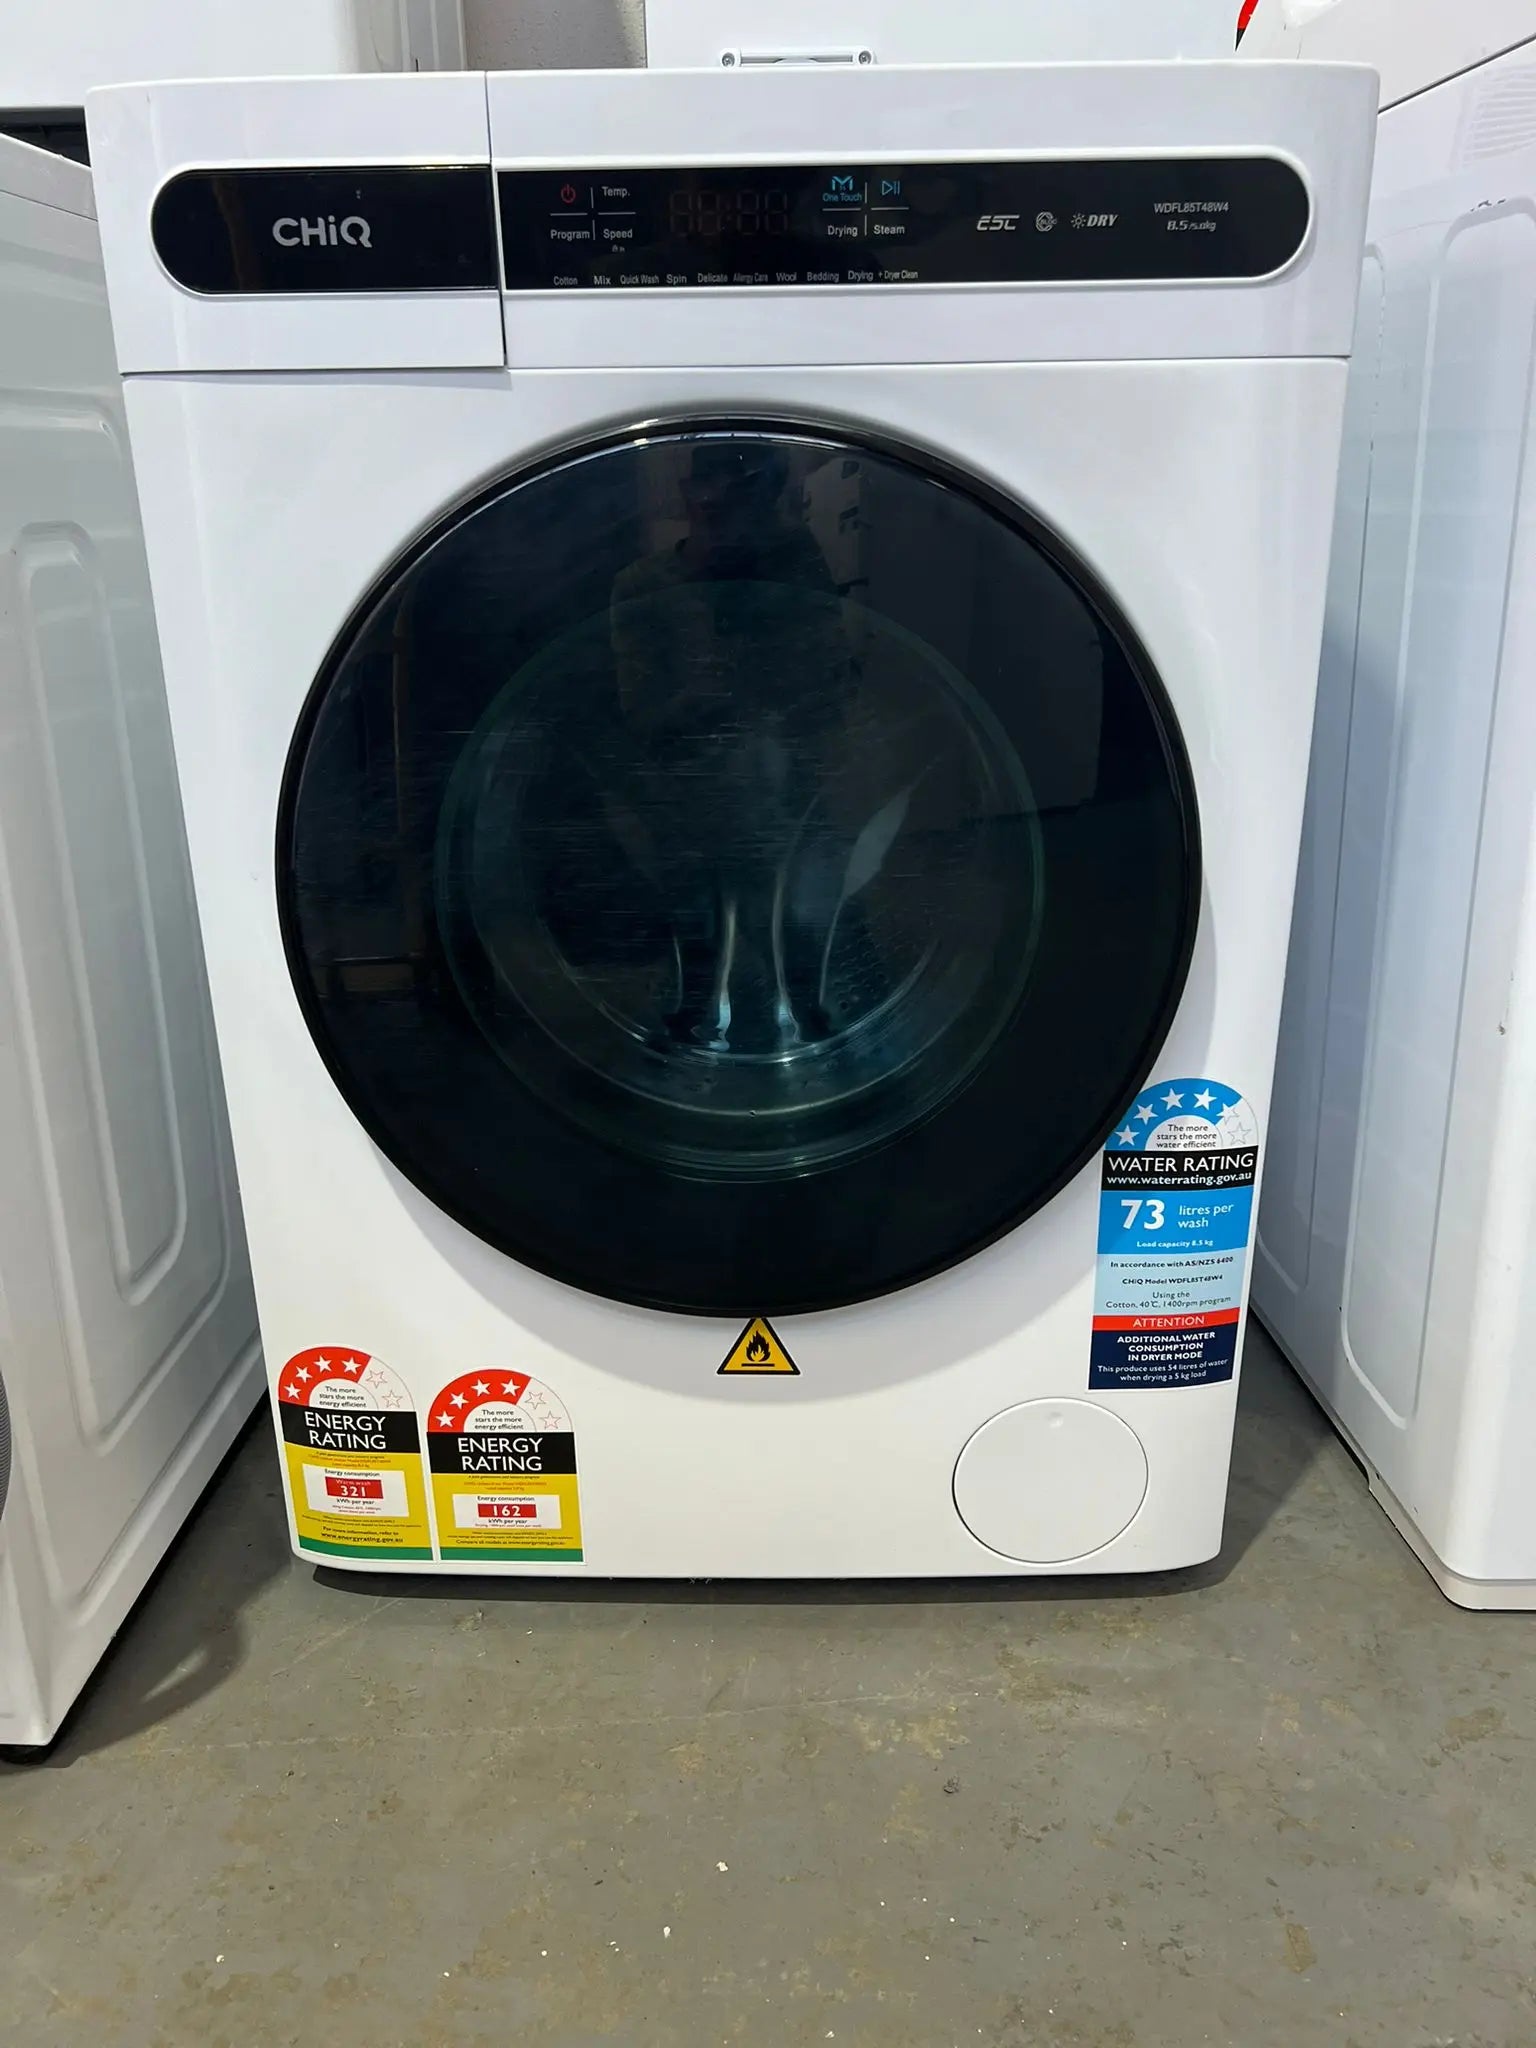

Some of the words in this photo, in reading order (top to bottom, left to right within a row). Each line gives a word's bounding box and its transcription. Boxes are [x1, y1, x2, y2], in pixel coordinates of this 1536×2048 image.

[602, 186, 630, 197] Temp.
[822, 193, 839, 202] One
[840, 192, 862, 202] Touch
[1154, 202, 1229, 213] WDFL85T48W4
[1087, 214, 1118, 227] DRY
[272, 215, 372, 248] CHiQ
[550, 229, 590, 241] Program
[603, 229, 633, 240] Speed
[827, 225, 858, 237] Drying
[873, 224, 905, 235] Steam
[593, 275, 611, 285] Mix
[620, 275, 639, 285] Quick
[641, 274, 660, 284] Wash
[666, 273, 687, 285] Spin
[697, 273, 728, 283] Delicate
[776, 272, 797, 282] Wool
[807, 271, 839, 282] Bedding
[848, 270, 874, 282] Drying
[884, 270, 900, 280] Dryer
[901, 269, 918, 279] Clean
[553, 276, 578, 286] Cotton
[1168, 1124, 1184, 1132] The
[1179, 1132, 1193, 1140] the
[1183, 1140, 1216, 1148] efficient
[1108, 1157, 1177, 1172] WATER
[1183, 1153, 1254, 1172] RATING
[1107, 1172, 1252, 1186] www.waterrating.gov.au
[1121, 1199, 1165, 1230] 73
[1179, 1205, 1210, 1216] litres
[1213, 1204, 1234, 1216] per
[1178, 1218, 1209, 1228] wash
[1158, 1240, 1190, 1248] capacity
[1205, 1239, 1214, 1247] kg
[1185, 1259, 1215, 1267] AS/NZS
[1152, 1292, 1175, 1300] Using
[1199, 1297, 1231, 1307] program
[1133, 1316, 1205, 1328] ATTENTION
[1117, 1335, 1182, 1343] ADDITIONAL
[1182, 1332, 1216, 1341] WATER
[1128, 1342, 1204, 1352] CONSUMPTION
[1141, 1353, 1173, 1361] DRYER
[1174, 1351, 1203, 1360] MODE
[1097, 1365, 1114, 1373] This
[1115, 1365, 1147, 1374] produce
[1207, 1359, 1228, 1367] water
[1142, 1374, 1167, 1382] drying
[319, 1400, 340, 1408] energy
[304, 1411, 386, 1432] ENERGY
[309, 1429, 387, 1450] RATING
[457, 1437, 543, 1453] ENERGY
[461, 1455, 543, 1471] RATING
[325, 1469, 343, 1477] Energy
[340, 1485, 366, 1497] 321
[492, 1505, 521, 1517] 162
[320, 1532, 403, 1543] www.energyrating.gov.au
